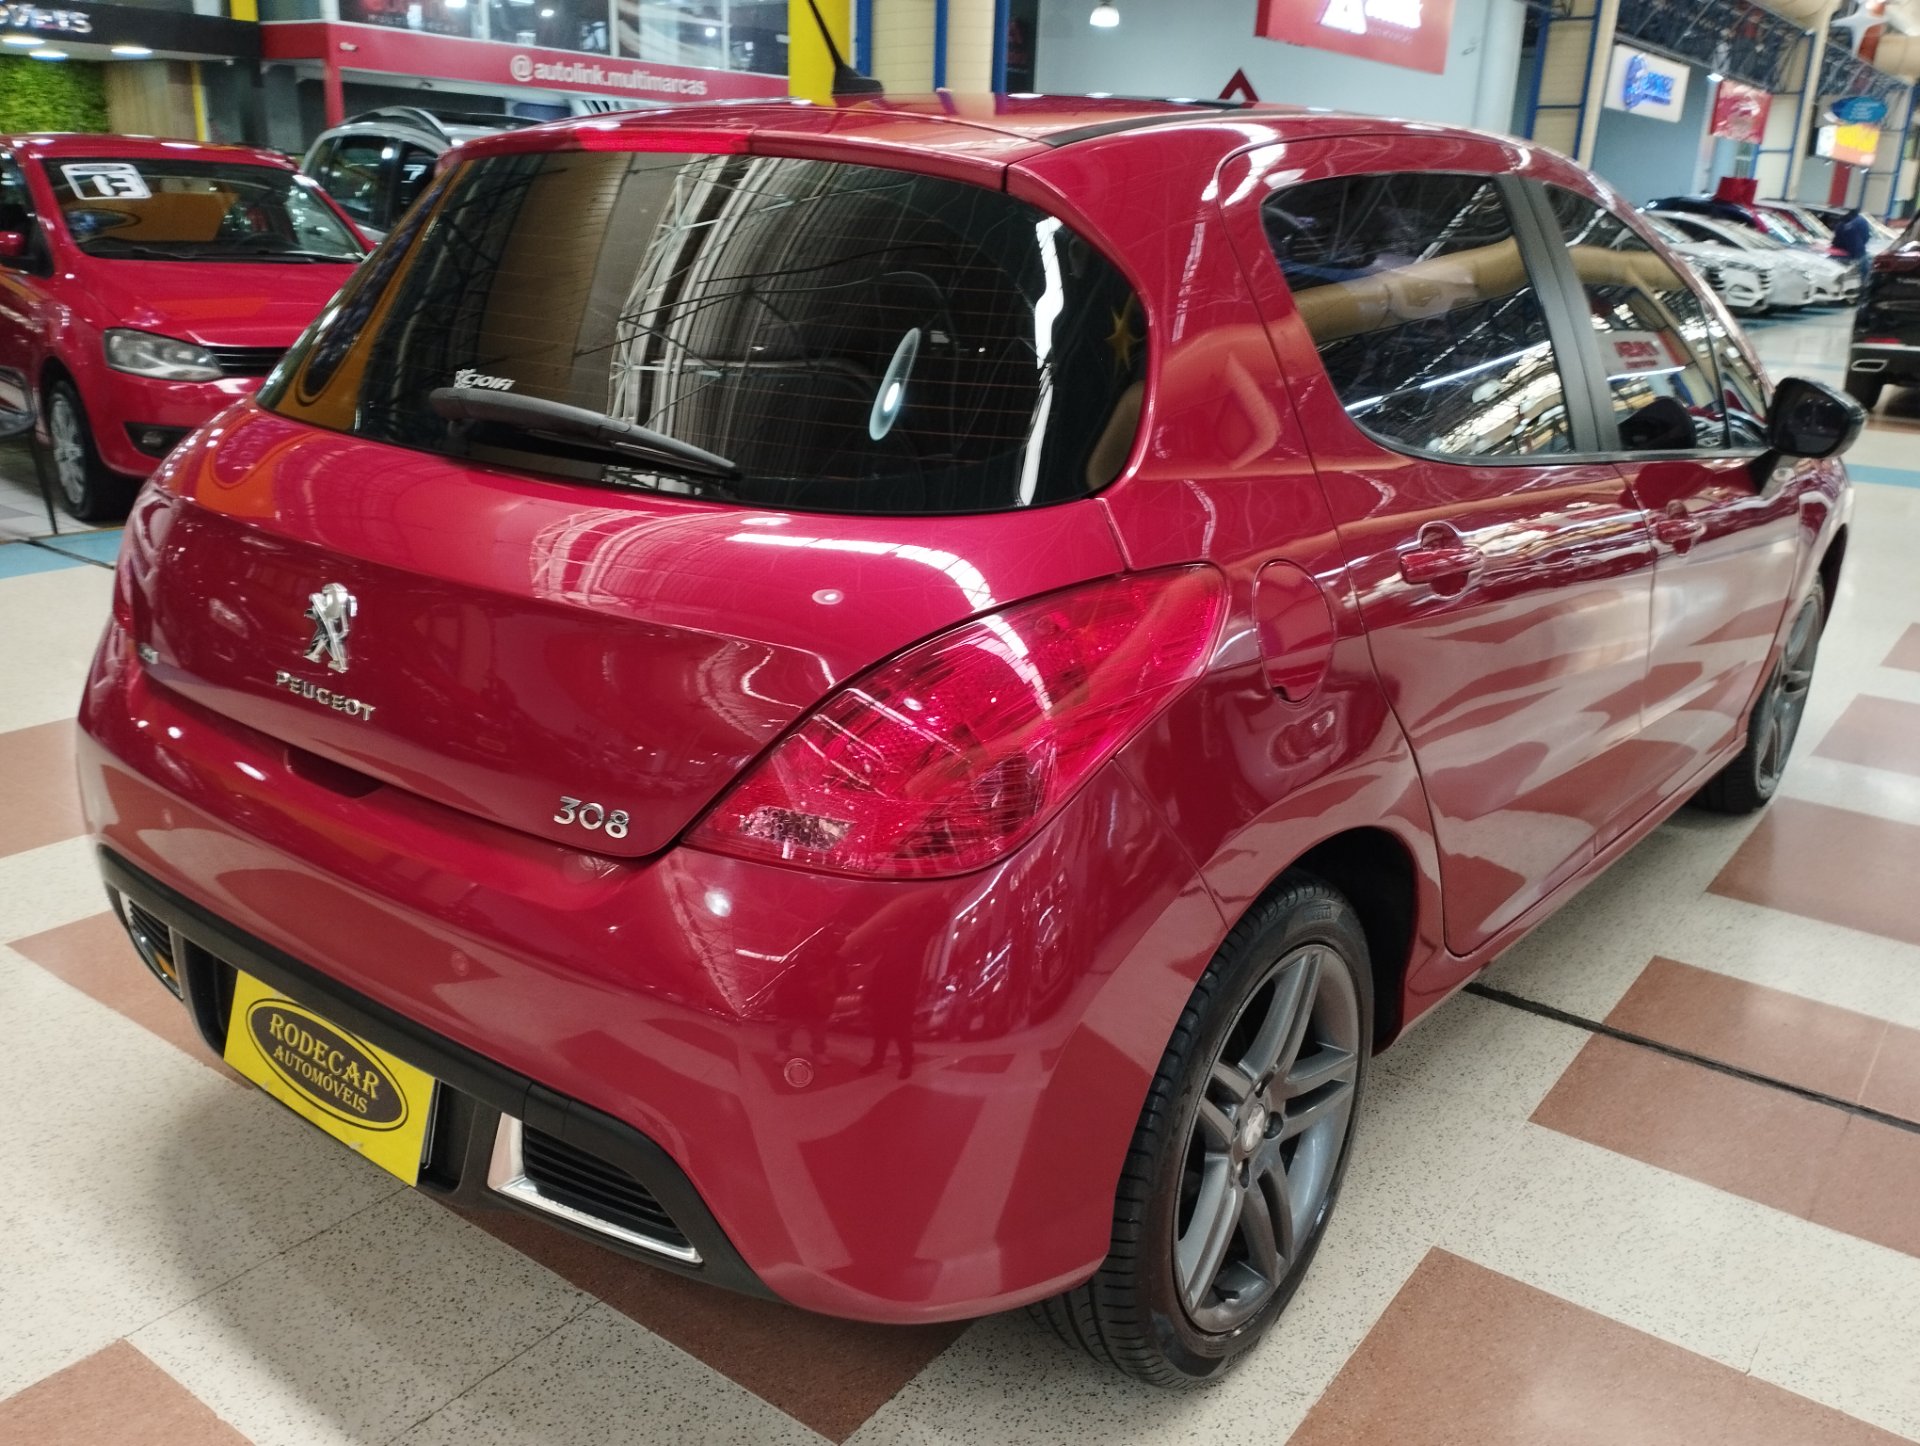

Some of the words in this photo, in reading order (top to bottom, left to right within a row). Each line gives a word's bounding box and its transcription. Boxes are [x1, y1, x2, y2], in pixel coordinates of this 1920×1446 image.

[510, 54, 708, 95] @autolink.multimarcas
[91, 173, 142, 197] 13
[276, 670, 376, 721] PEUGEOT
[553, 795, 630, 839] 308
[269, 1013, 380, 1099] RODECAR
[273, 1045, 368, 1114] AUTOMÓVEIS
